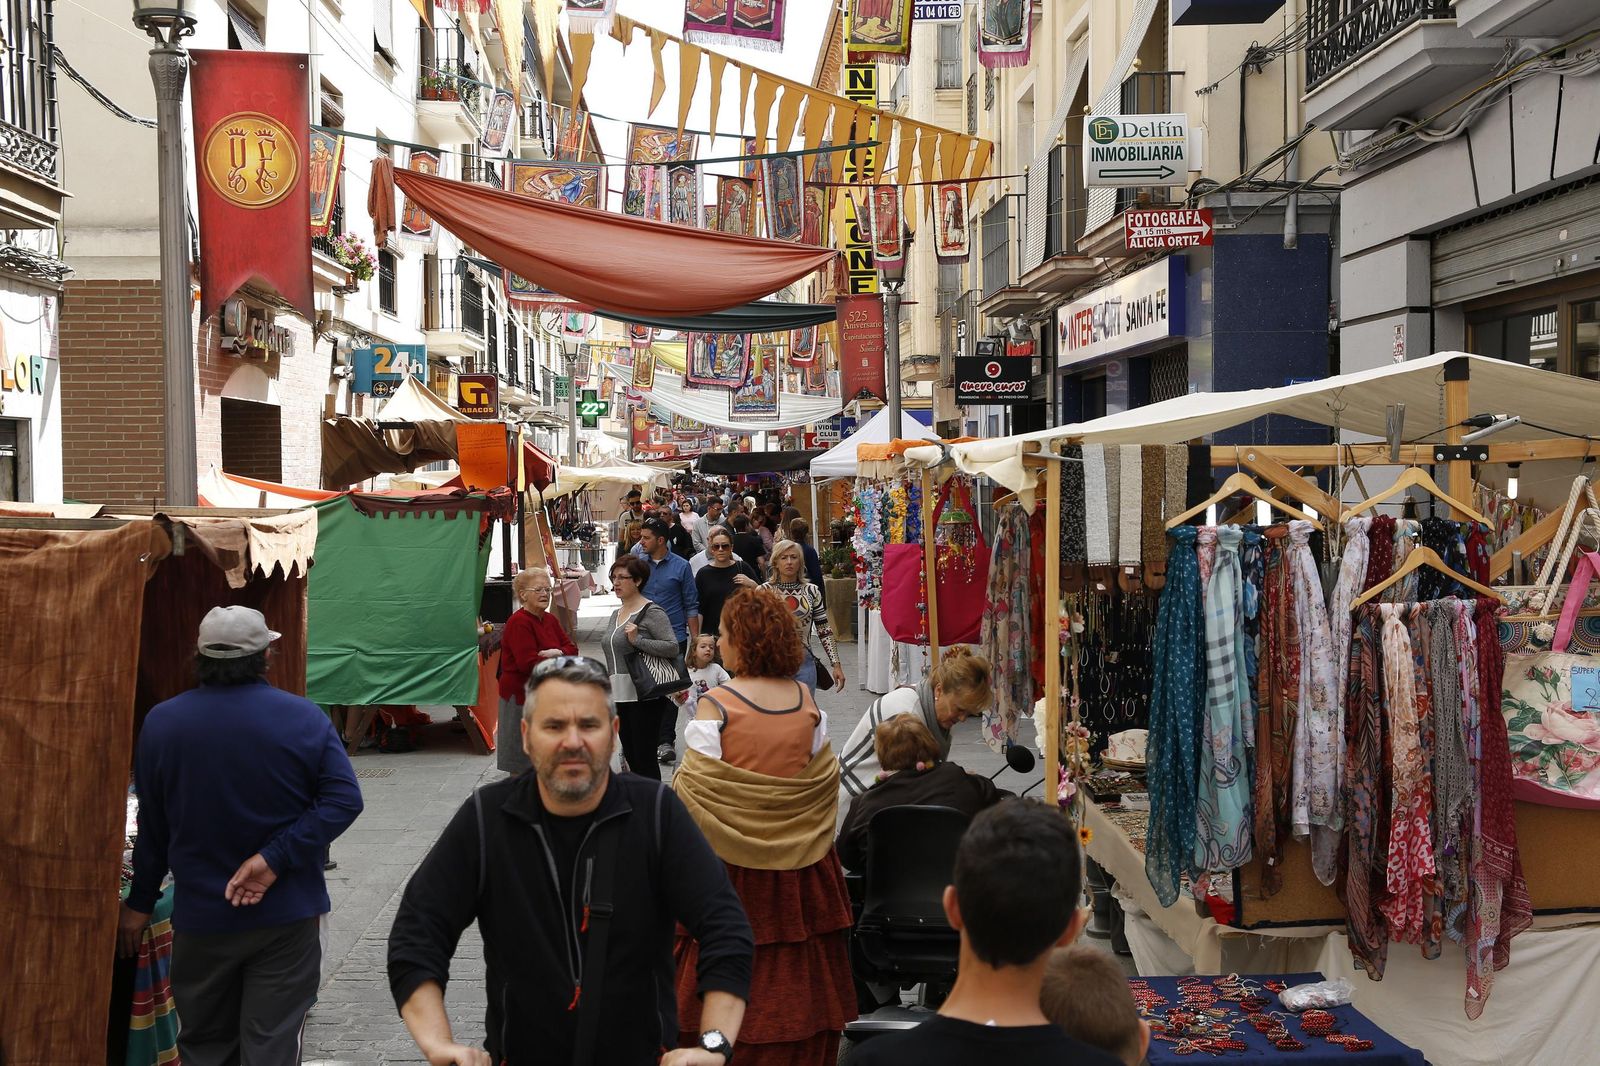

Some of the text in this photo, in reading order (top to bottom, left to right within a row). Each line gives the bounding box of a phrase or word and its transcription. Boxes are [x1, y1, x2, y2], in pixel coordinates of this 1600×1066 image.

[926, 6, 935, 18] 04
[938, 5, 947, 17] 01
[1121, 121, 1183, 138] Delfín
[1091, 145, 1184, 162] INMOBILIARIA
[1127, 211, 1201, 227] FOTOGRAFA
[1156, 227, 1174, 235] mts.
[1129, 235, 1200, 248] ALICIA ORTIZ
[849, 310, 868, 322] 525
[1126, 295, 1153, 332] SANTA
[1156, 289, 1166, 322] FE
[843, 320, 882, 329] Aniversario
[374, 347, 423, 380] 24h
[994, 381, 1026, 391] euros
[1571, 666, 1595, 674] SUPER
